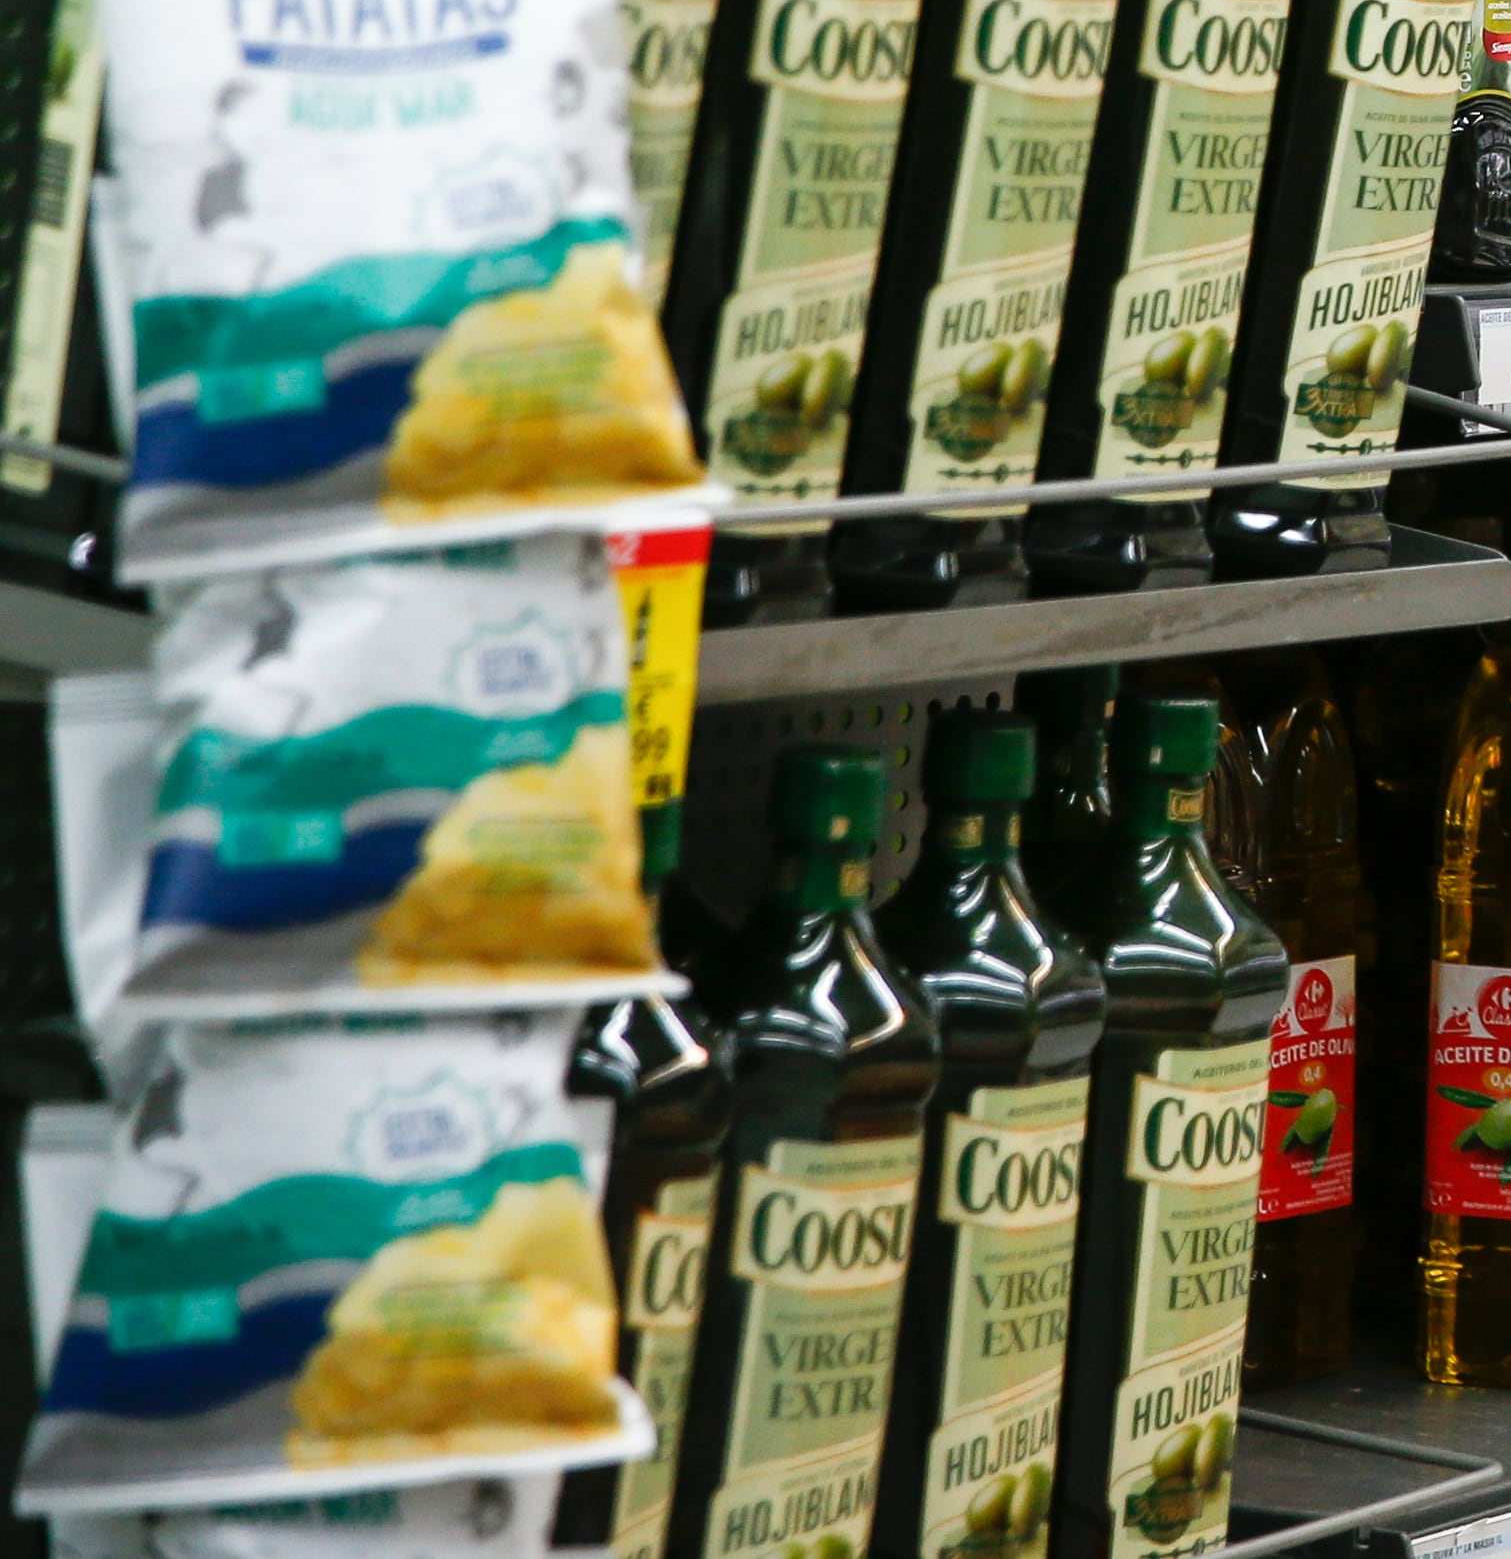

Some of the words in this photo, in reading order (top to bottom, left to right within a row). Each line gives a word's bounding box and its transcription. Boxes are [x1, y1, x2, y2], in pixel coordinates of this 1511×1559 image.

[1481, 311, 1503, 324] ACEITE
[1309, 1039, 1325, 1059] DE
[1434, 1045, 1495, 1066] ACEITE
